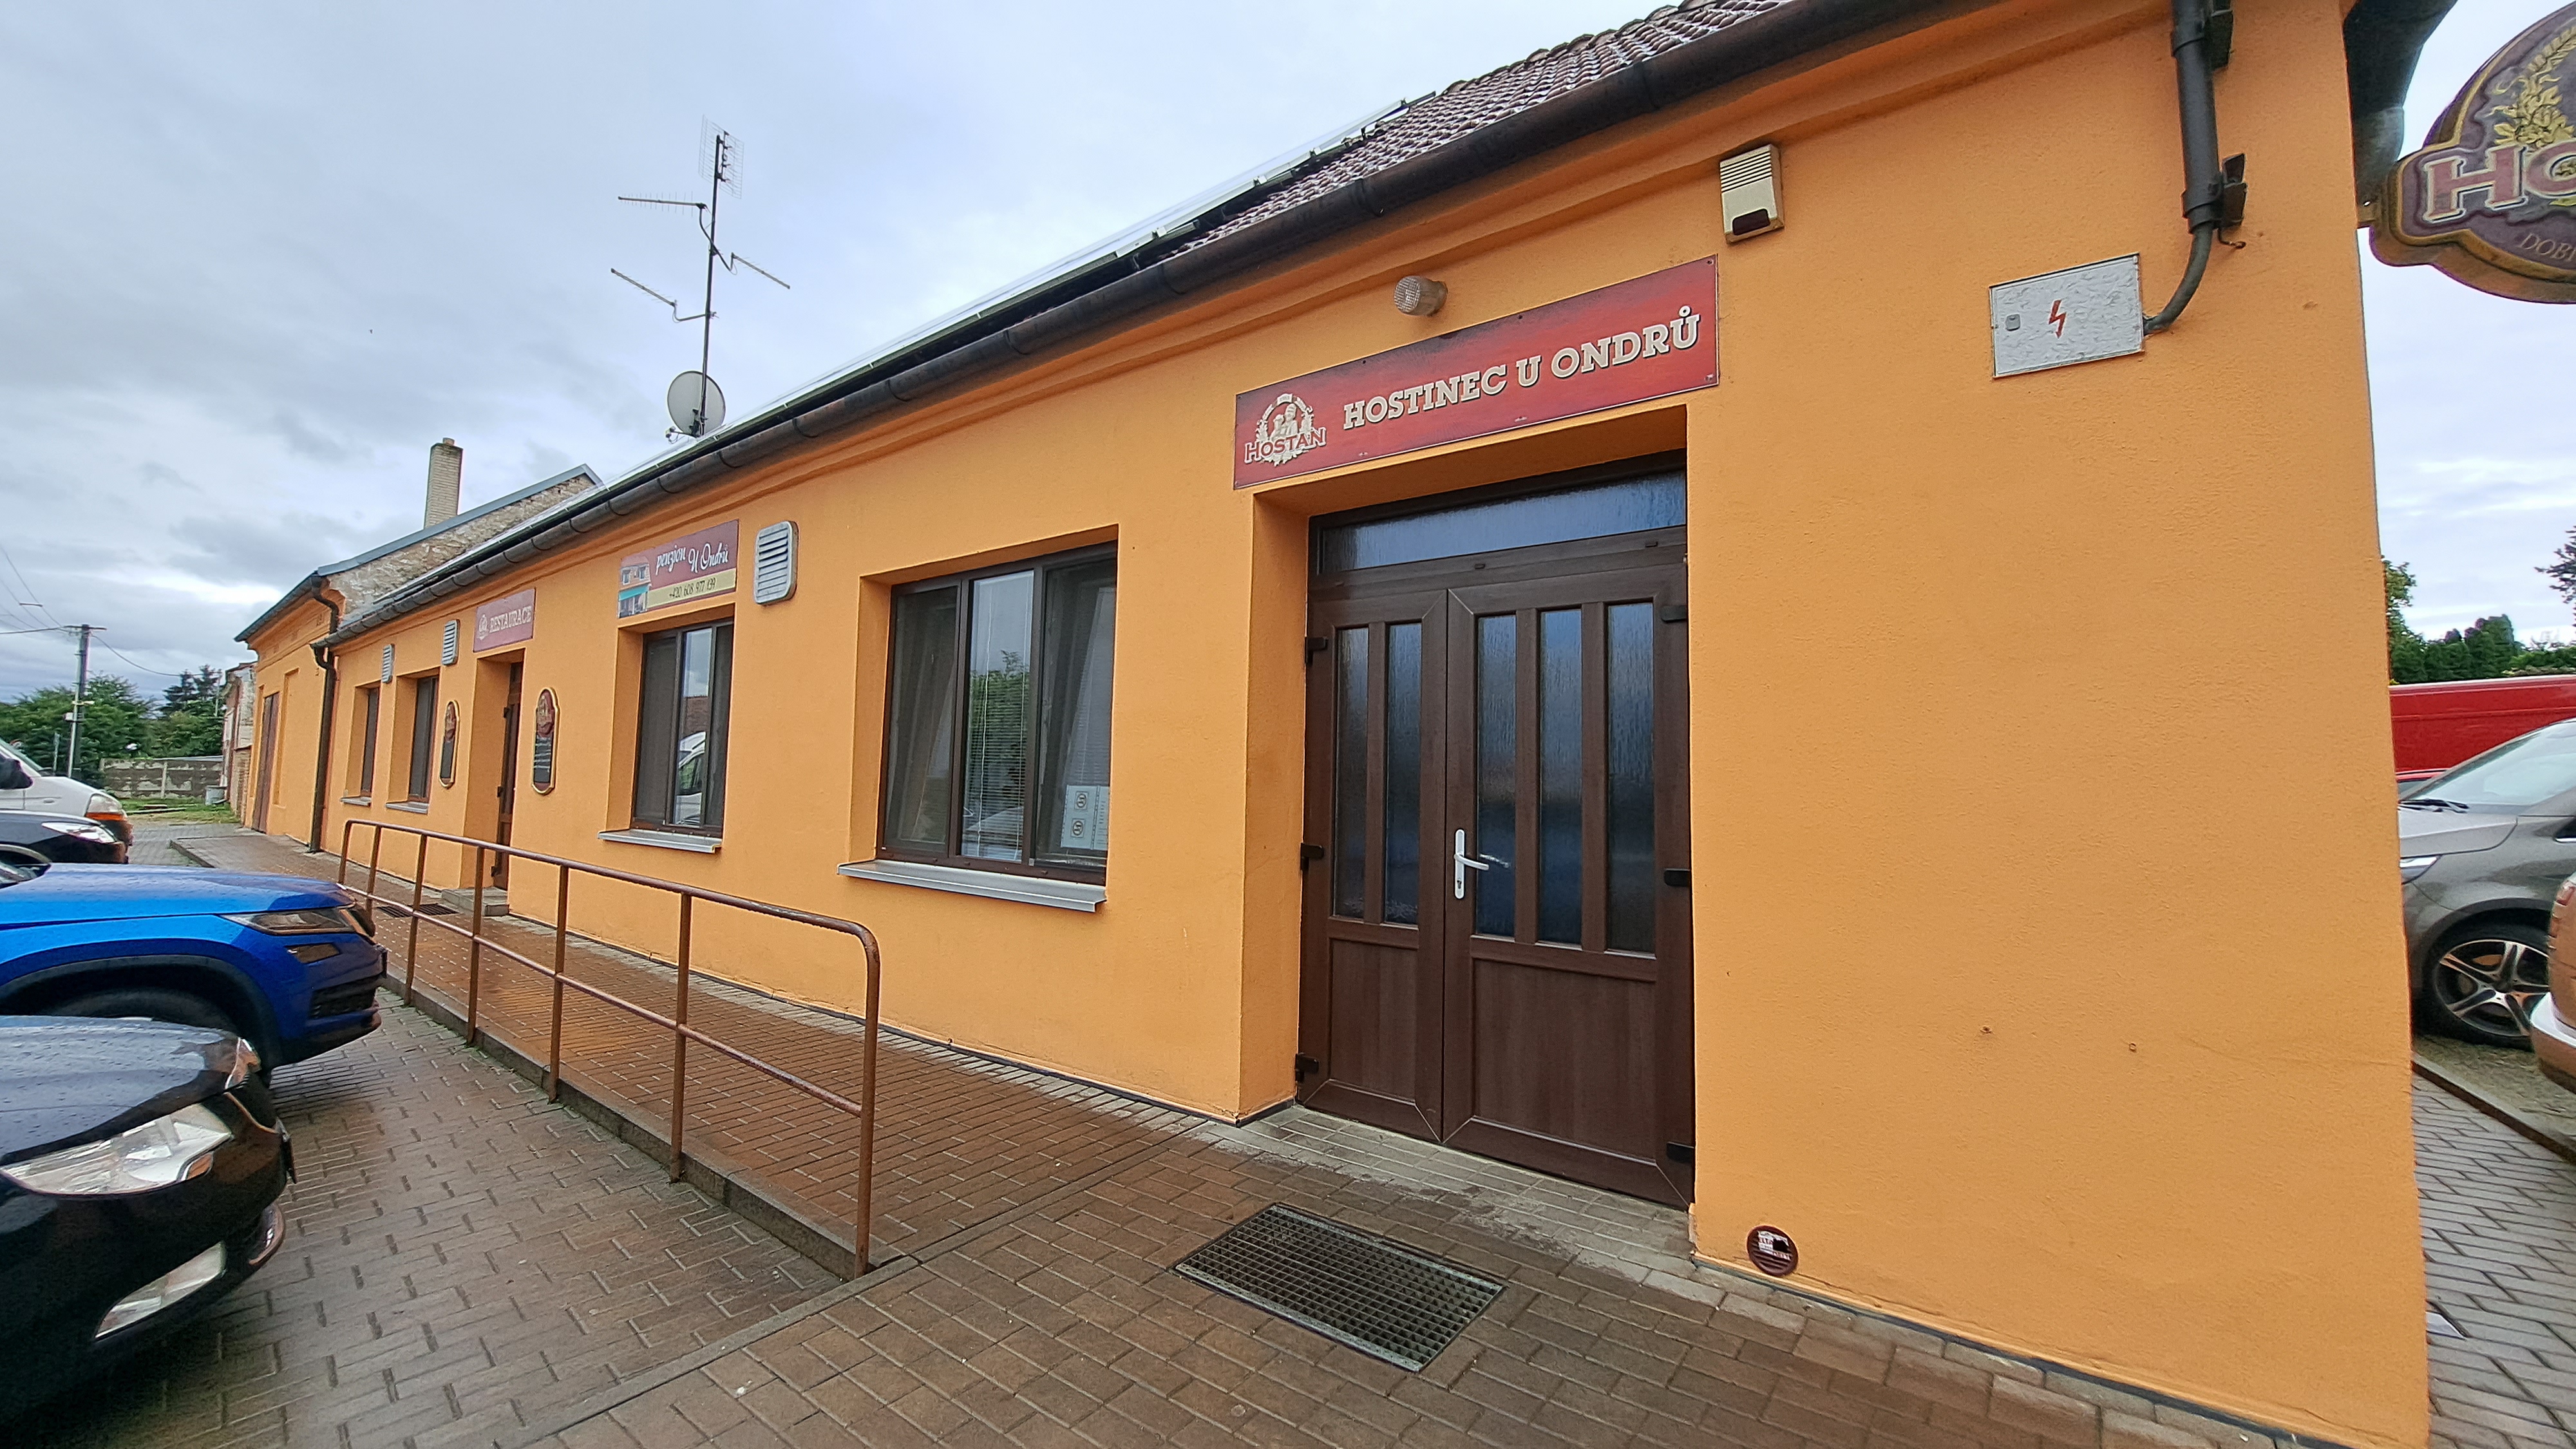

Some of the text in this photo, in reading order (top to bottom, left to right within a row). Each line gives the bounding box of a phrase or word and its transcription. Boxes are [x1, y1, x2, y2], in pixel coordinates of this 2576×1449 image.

[1343, 365, 1508, 430] HOSTINEC
[1516, 355, 1542, 387] U
[1551, 305, 1701, 379] ONDRŮ
[1244, 426, 1327, 464] HOSTAN
[656, 542, 728, 575] penzion U Ondrů
[489, 605, 532, 634] RESTAURACE
